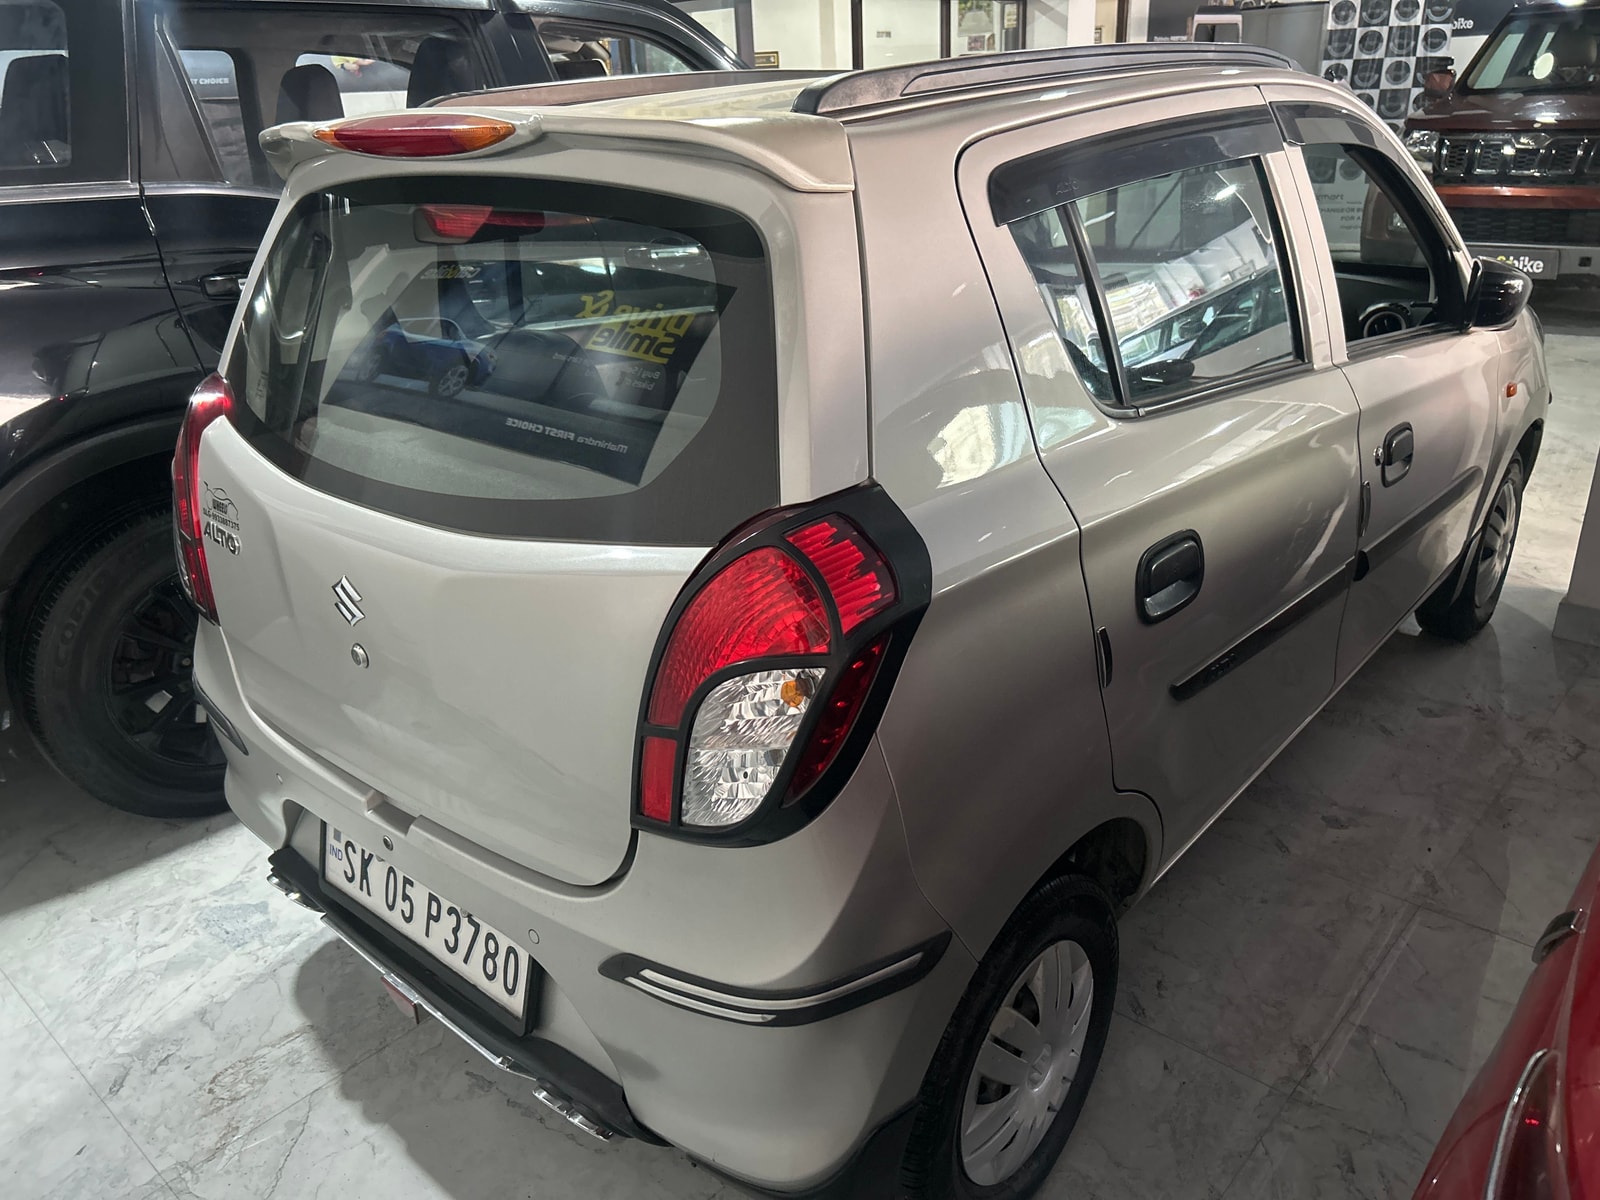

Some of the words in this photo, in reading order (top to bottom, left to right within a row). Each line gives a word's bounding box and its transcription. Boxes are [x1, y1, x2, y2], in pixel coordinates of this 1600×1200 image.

[329, 843, 343, 862] IND
[343, 840, 374, 897] SK
[384, 865, 414, 924] 05
[424, 891, 520, 997] P3780
